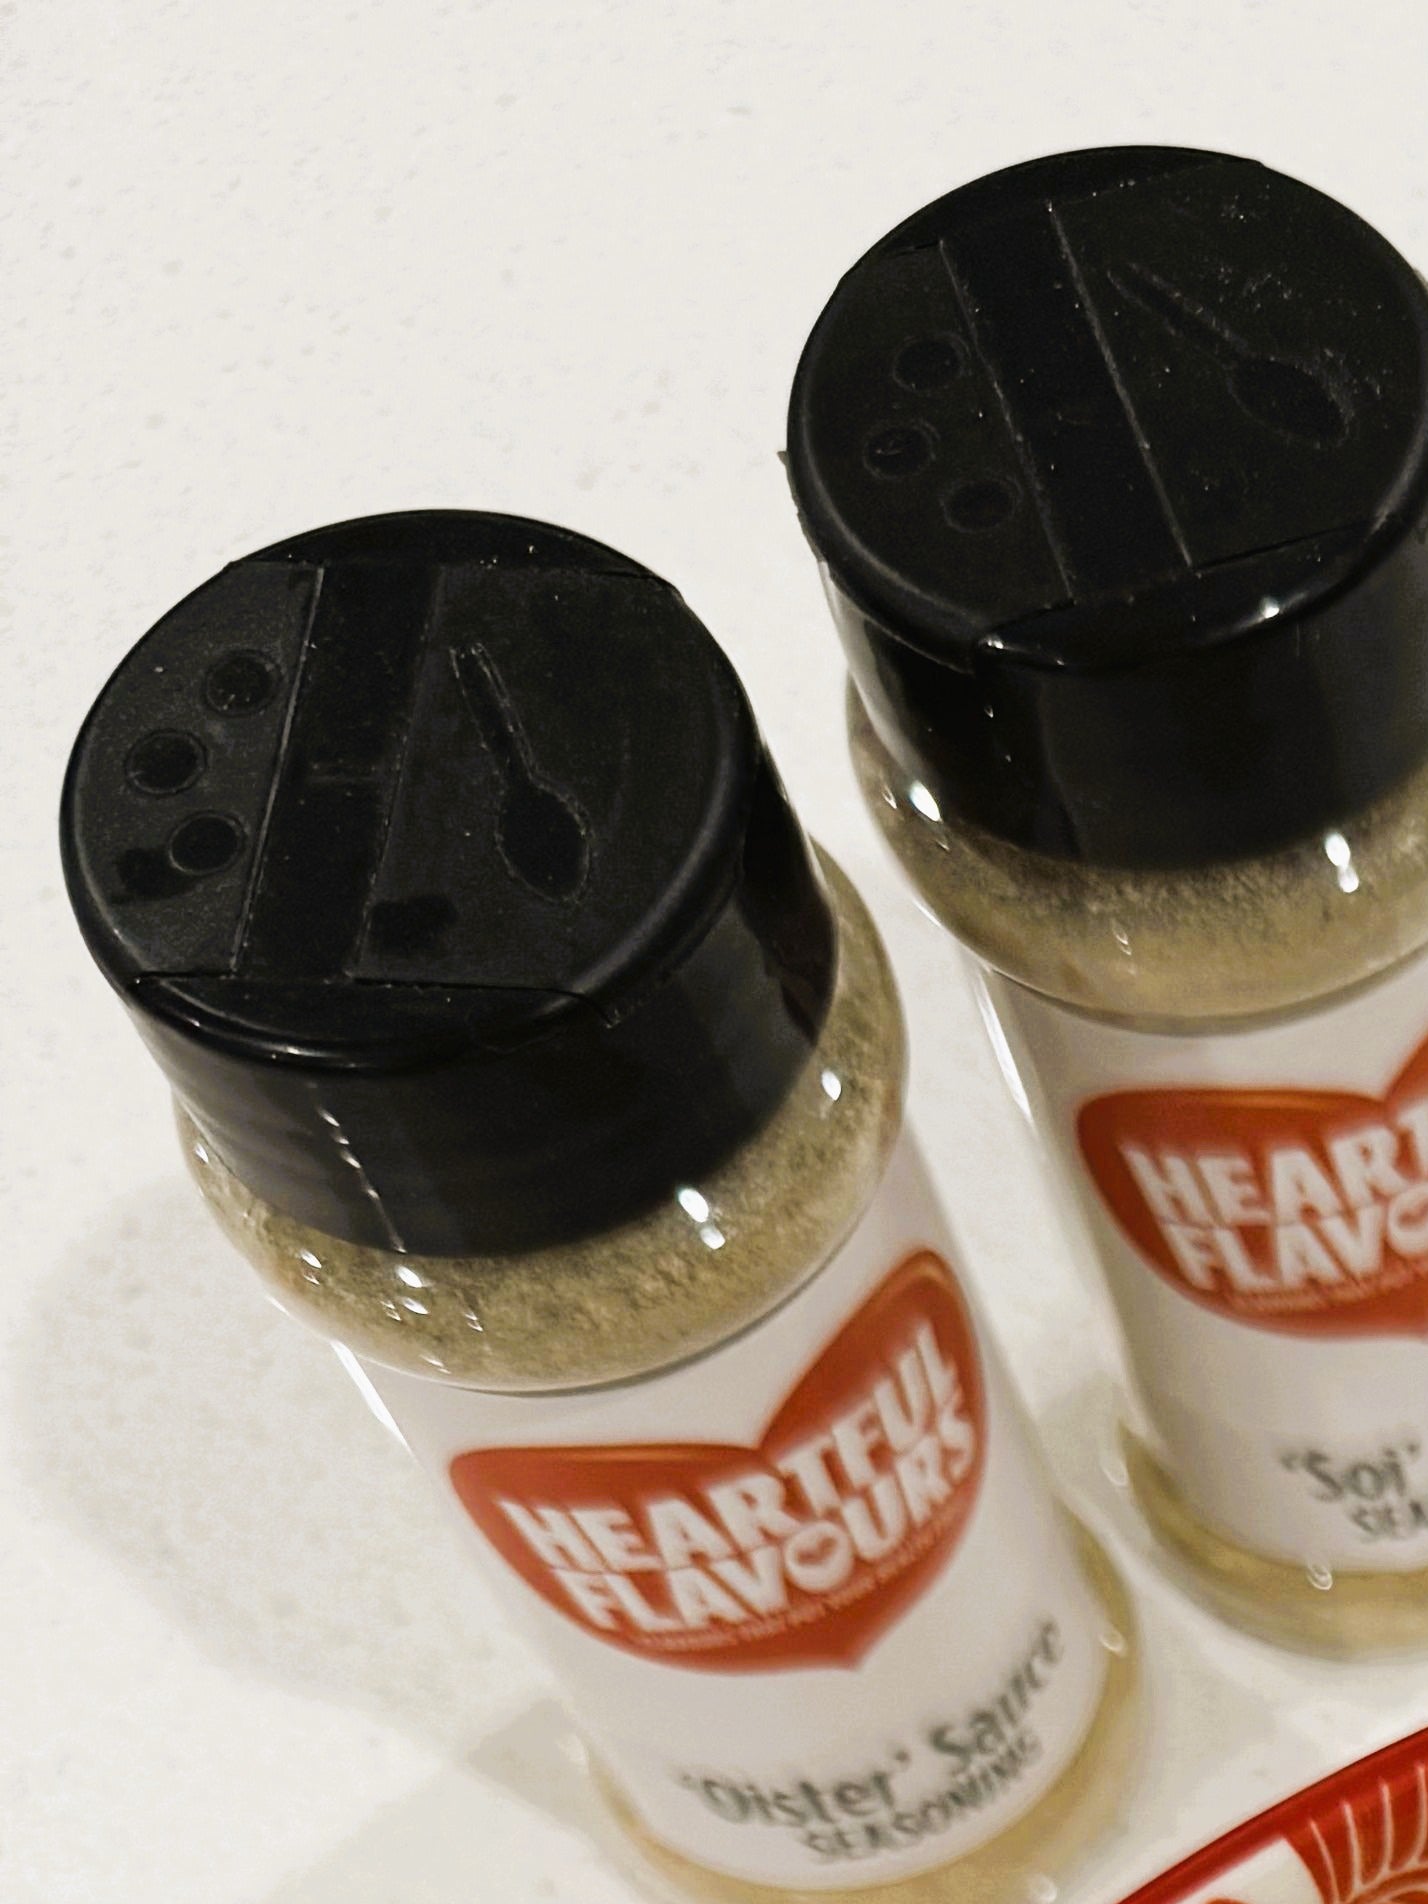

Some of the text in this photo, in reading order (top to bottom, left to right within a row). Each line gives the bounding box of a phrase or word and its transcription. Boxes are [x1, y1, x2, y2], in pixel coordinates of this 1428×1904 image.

[499, 1318, 958, 1571] HEARTFUL
[550, 1405, 976, 1629] FLAVOURS
[799, 1733, 1042, 1865] SEASONING
